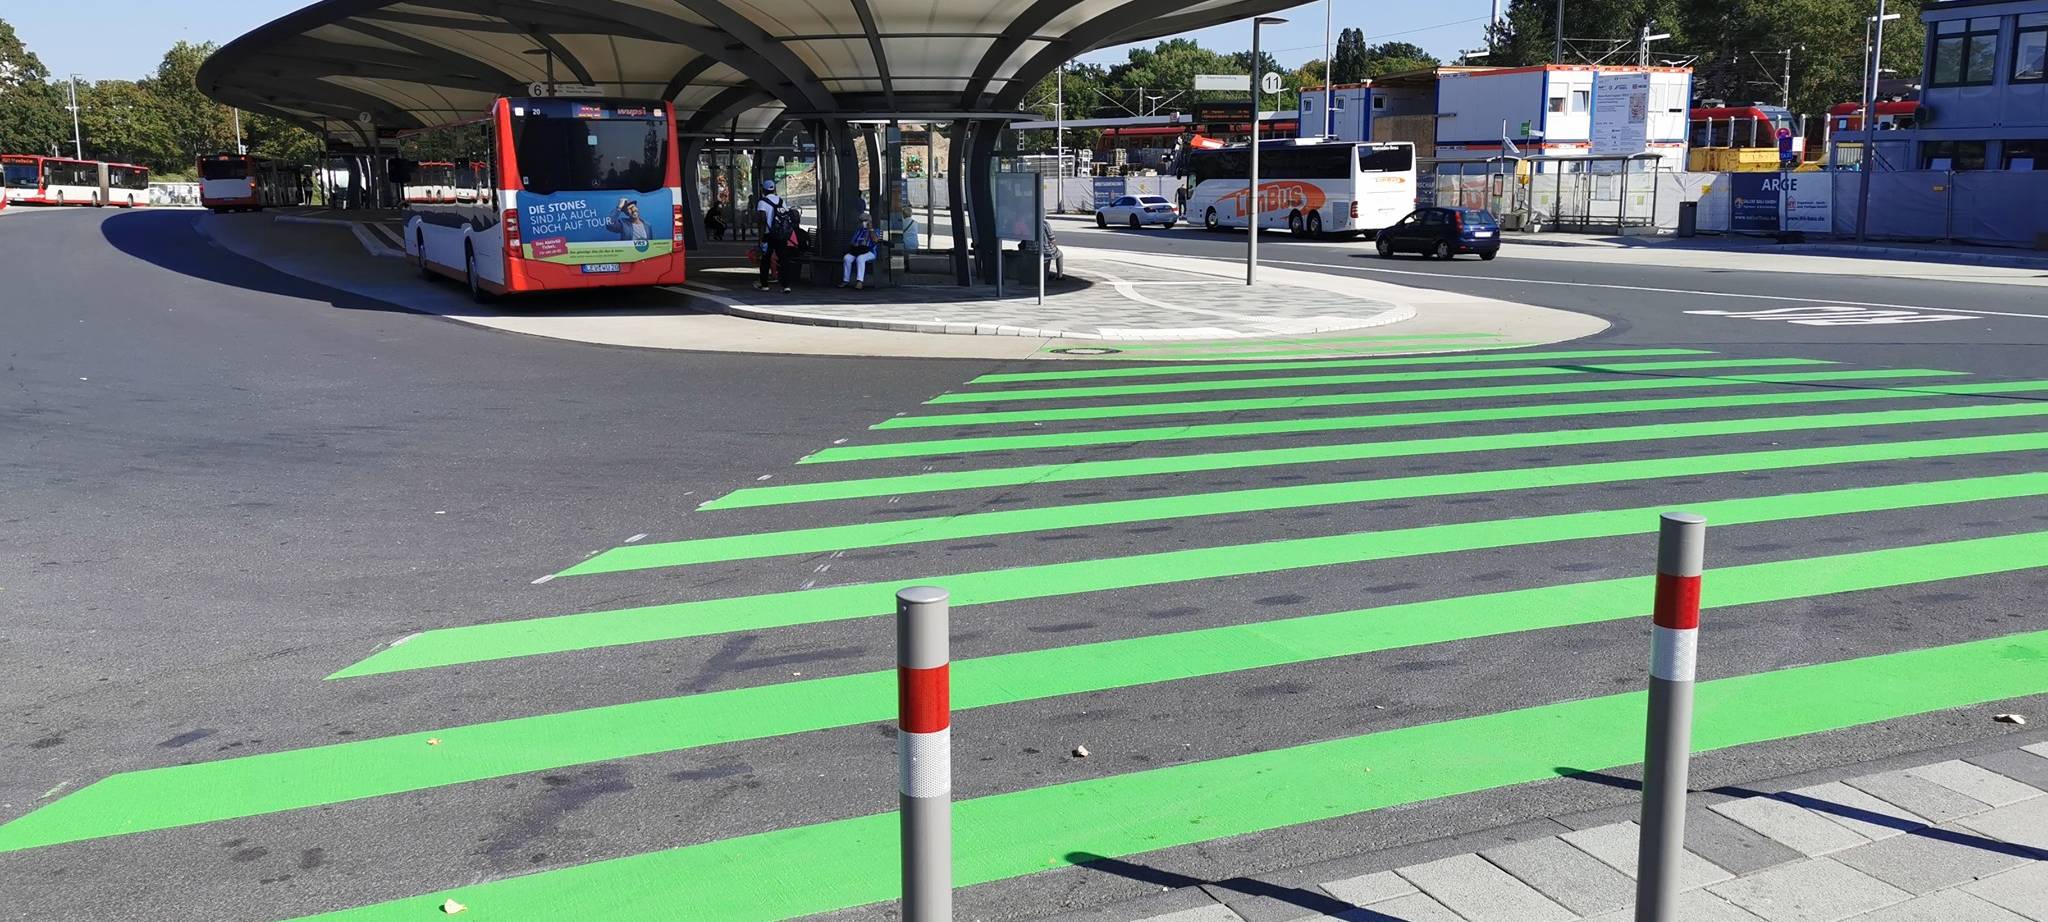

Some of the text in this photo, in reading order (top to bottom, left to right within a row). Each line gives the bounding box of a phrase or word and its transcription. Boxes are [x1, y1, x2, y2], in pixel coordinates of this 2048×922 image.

[1265, 76, 1279, 89] 11
[533, 85, 542, 97] 6
[617, 107, 647, 117] wupsi
[1761, 178, 1797, 192] ARGE
[528, 200, 587, 215] DIE STONES
[530, 208, 597, 225] SIND JA AUCH
[532, 216, 615, 235] NOCH AUF TOUR.
